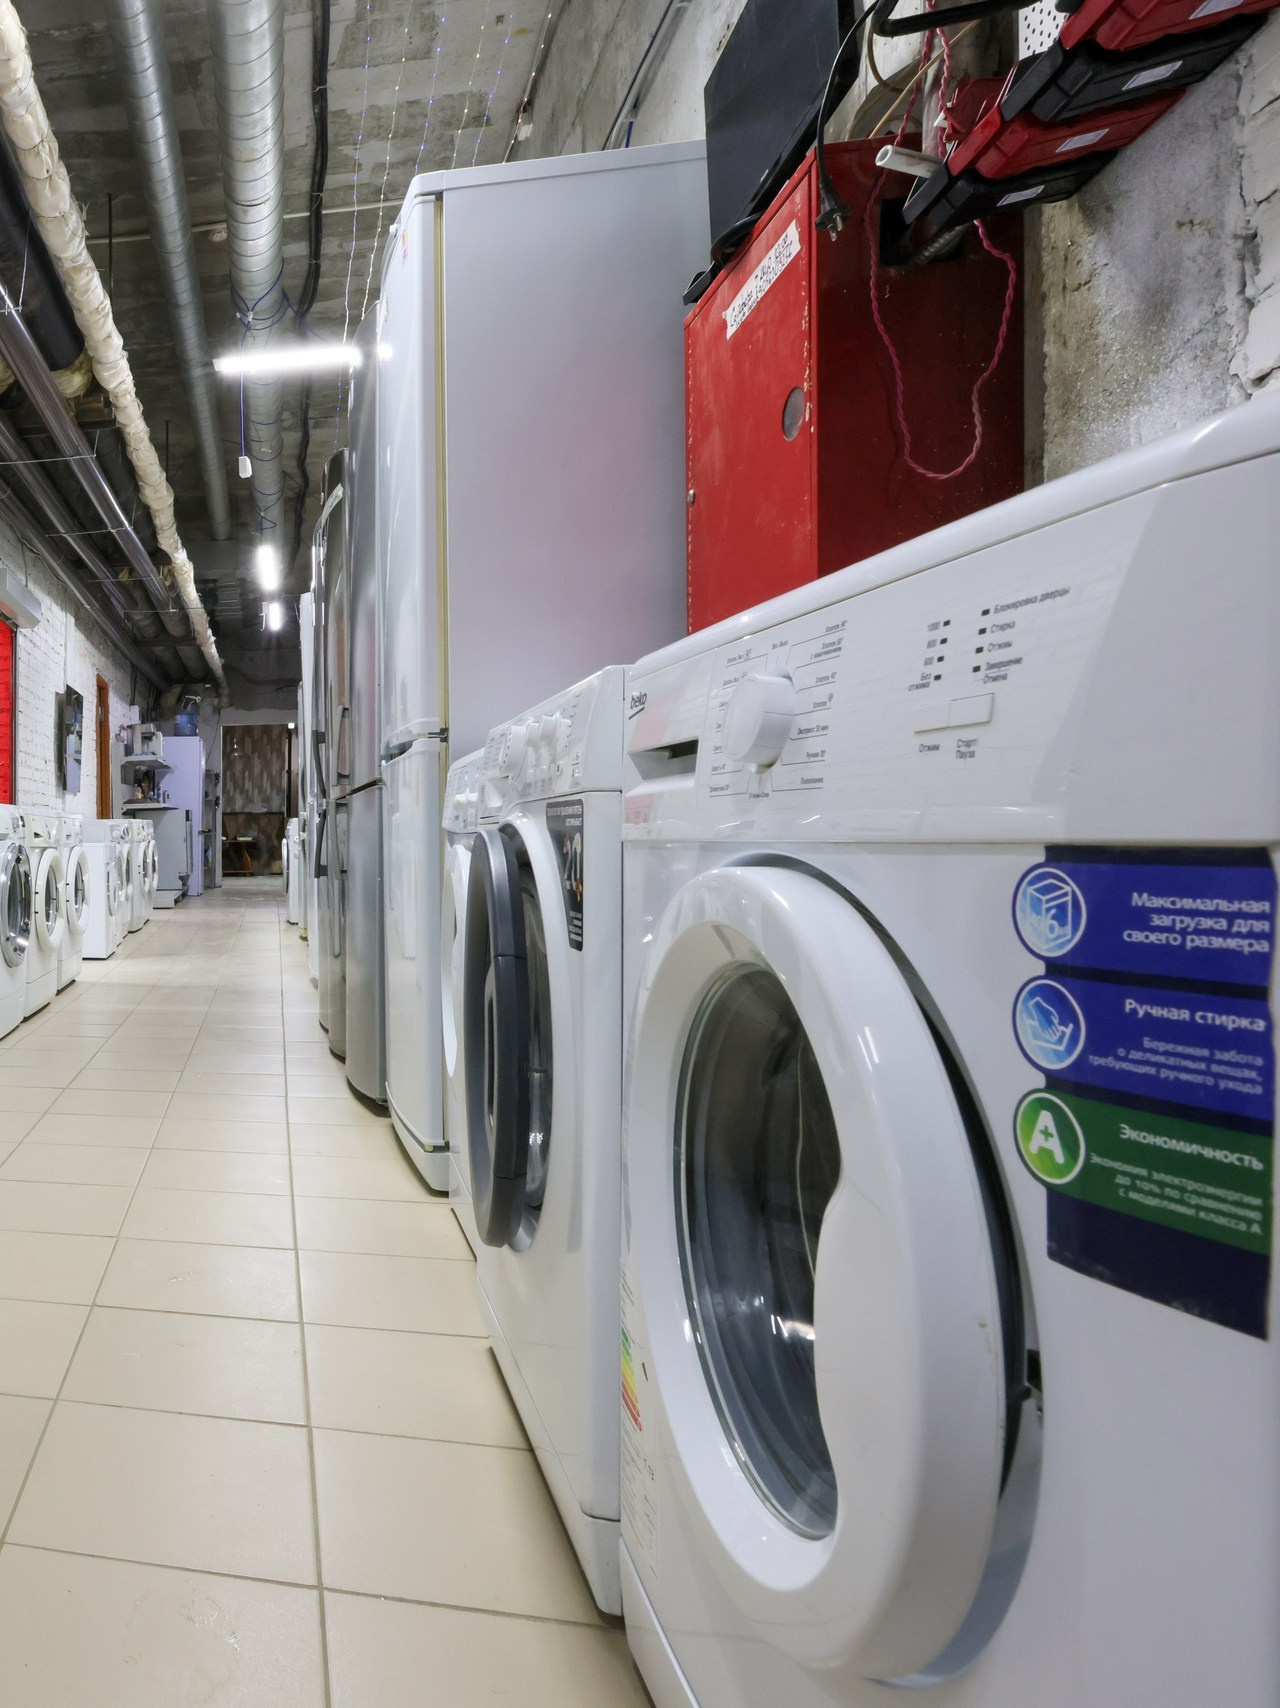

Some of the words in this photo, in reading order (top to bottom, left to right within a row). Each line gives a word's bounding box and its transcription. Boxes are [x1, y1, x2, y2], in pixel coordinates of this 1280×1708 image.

[993, 595, 1038, 614] Блокировка
[990, 621, 1016, 634] Стирка
[630, 690, 648, 710] beko
[1131, 892, 1270, 914] Максимальная
[1150, 914, 1228, 932] загрузка
[1231, 919, 1270, 934] для
[1123, 930, 1182, 945] своего
[1186, 934, 1270, 955] размера
[1125, 998, 1190, 1019] Ручная
[1195, 1011, 1266, 1031] стирка
[1117, 1048, 1126, 1057] о
[1128, 1049, 1207, 1071] деликатных
[1210, 1063, 1264, 1082] вещах,
[1143, 1037, 1210, 1058] Бережная
[1213, 1050, 1264, 1066] забота
[1088, 1055, 1157, 1076] требующих
[1160, 1068, 1215, 1086] ручного
[1218, 1078, 1263, 1095] ухода
[1120, 1123, 1264, 1171] Экономичность
[1089, 1152, 1149, 1177] Экономия
[1151, 1170, 1263, 1207] электроэнергии
[1115, 1175, 1131, 1187] до
[1135, 1180, 1162, 1194] 10%
[1164, 1186, 1181, 1199] по
[1183, 1192, 1263, 1222] сравнению
[1128, 1190, 1196, 1216] моделями
[1198, 1211, 1248, 1231] класса
